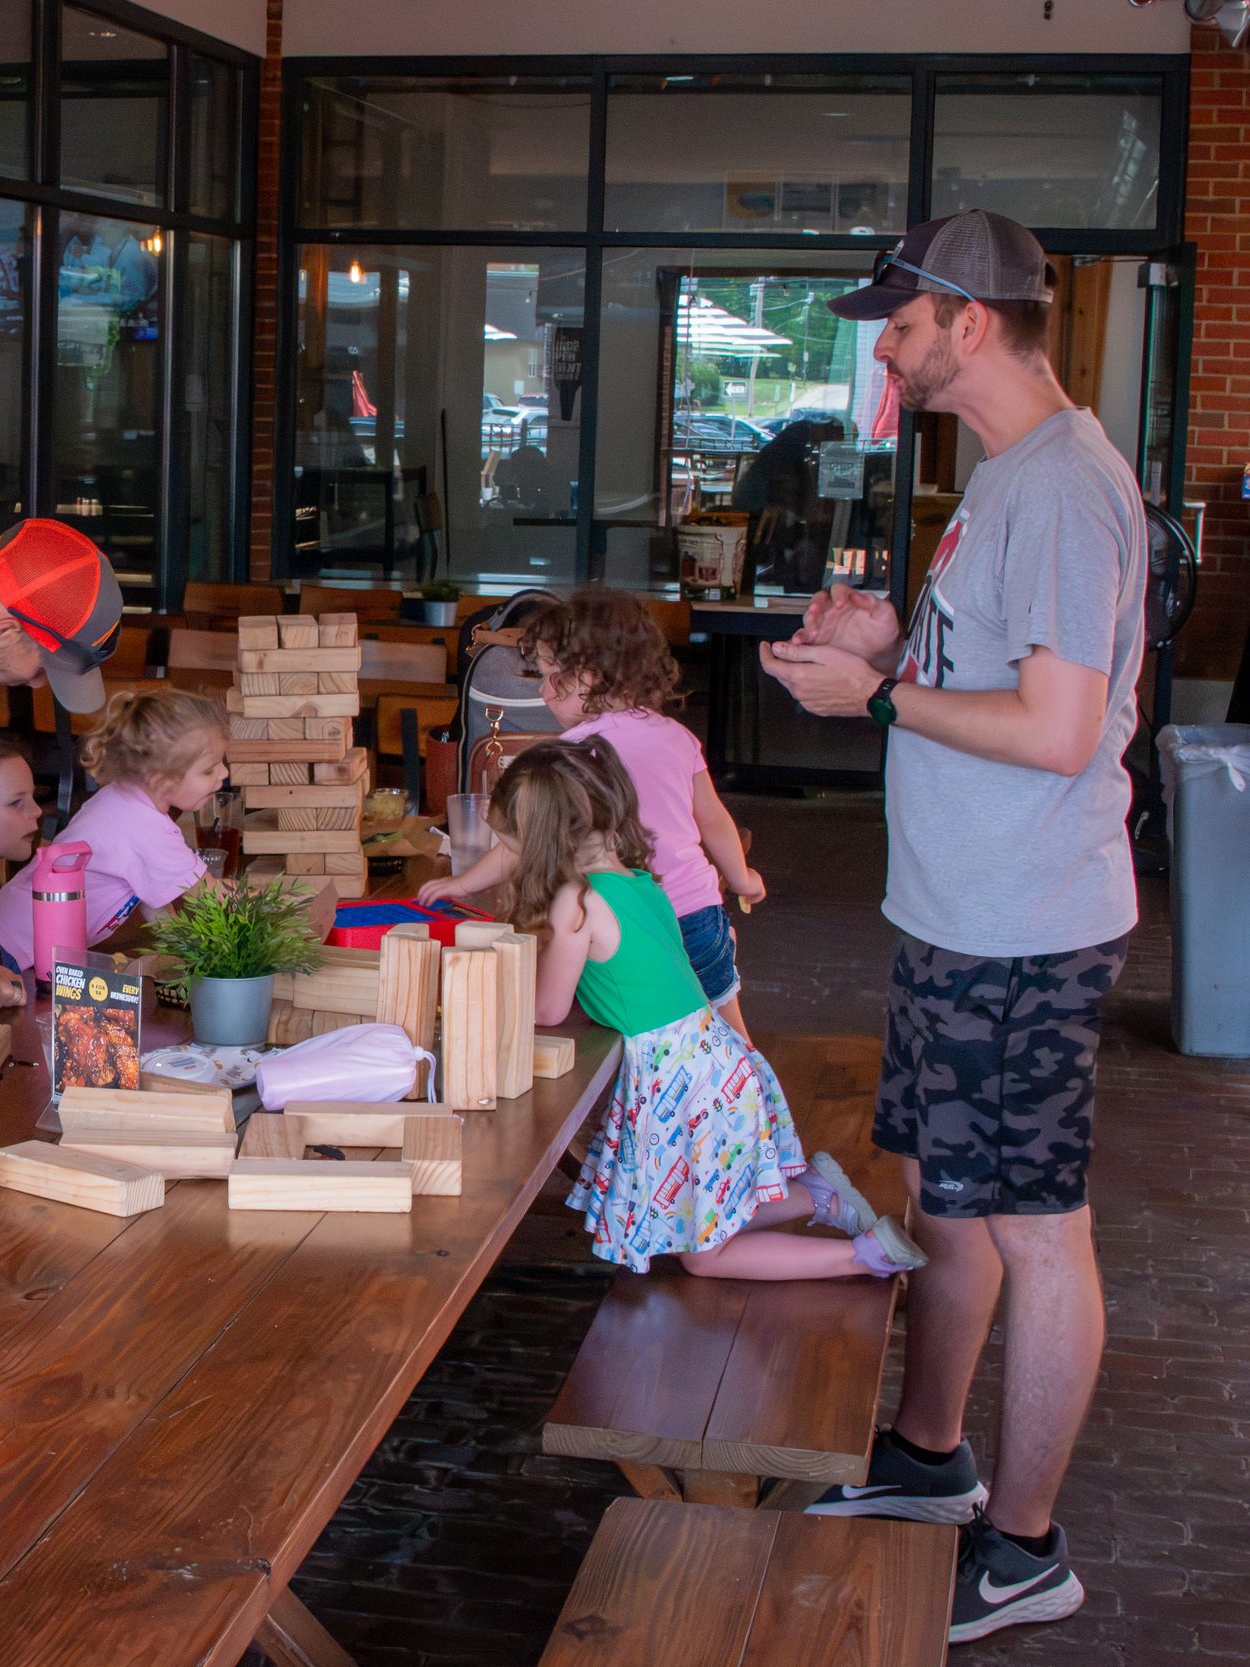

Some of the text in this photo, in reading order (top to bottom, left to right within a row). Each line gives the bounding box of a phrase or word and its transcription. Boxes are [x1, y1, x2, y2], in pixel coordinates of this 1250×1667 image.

[56, 965, 84, 978] OVEN BAKED
[56, 974, 86, 990] CHICKEN
[56, 984, 82, 1001] WINGS
[122, 984, 139, 996] EVERY
